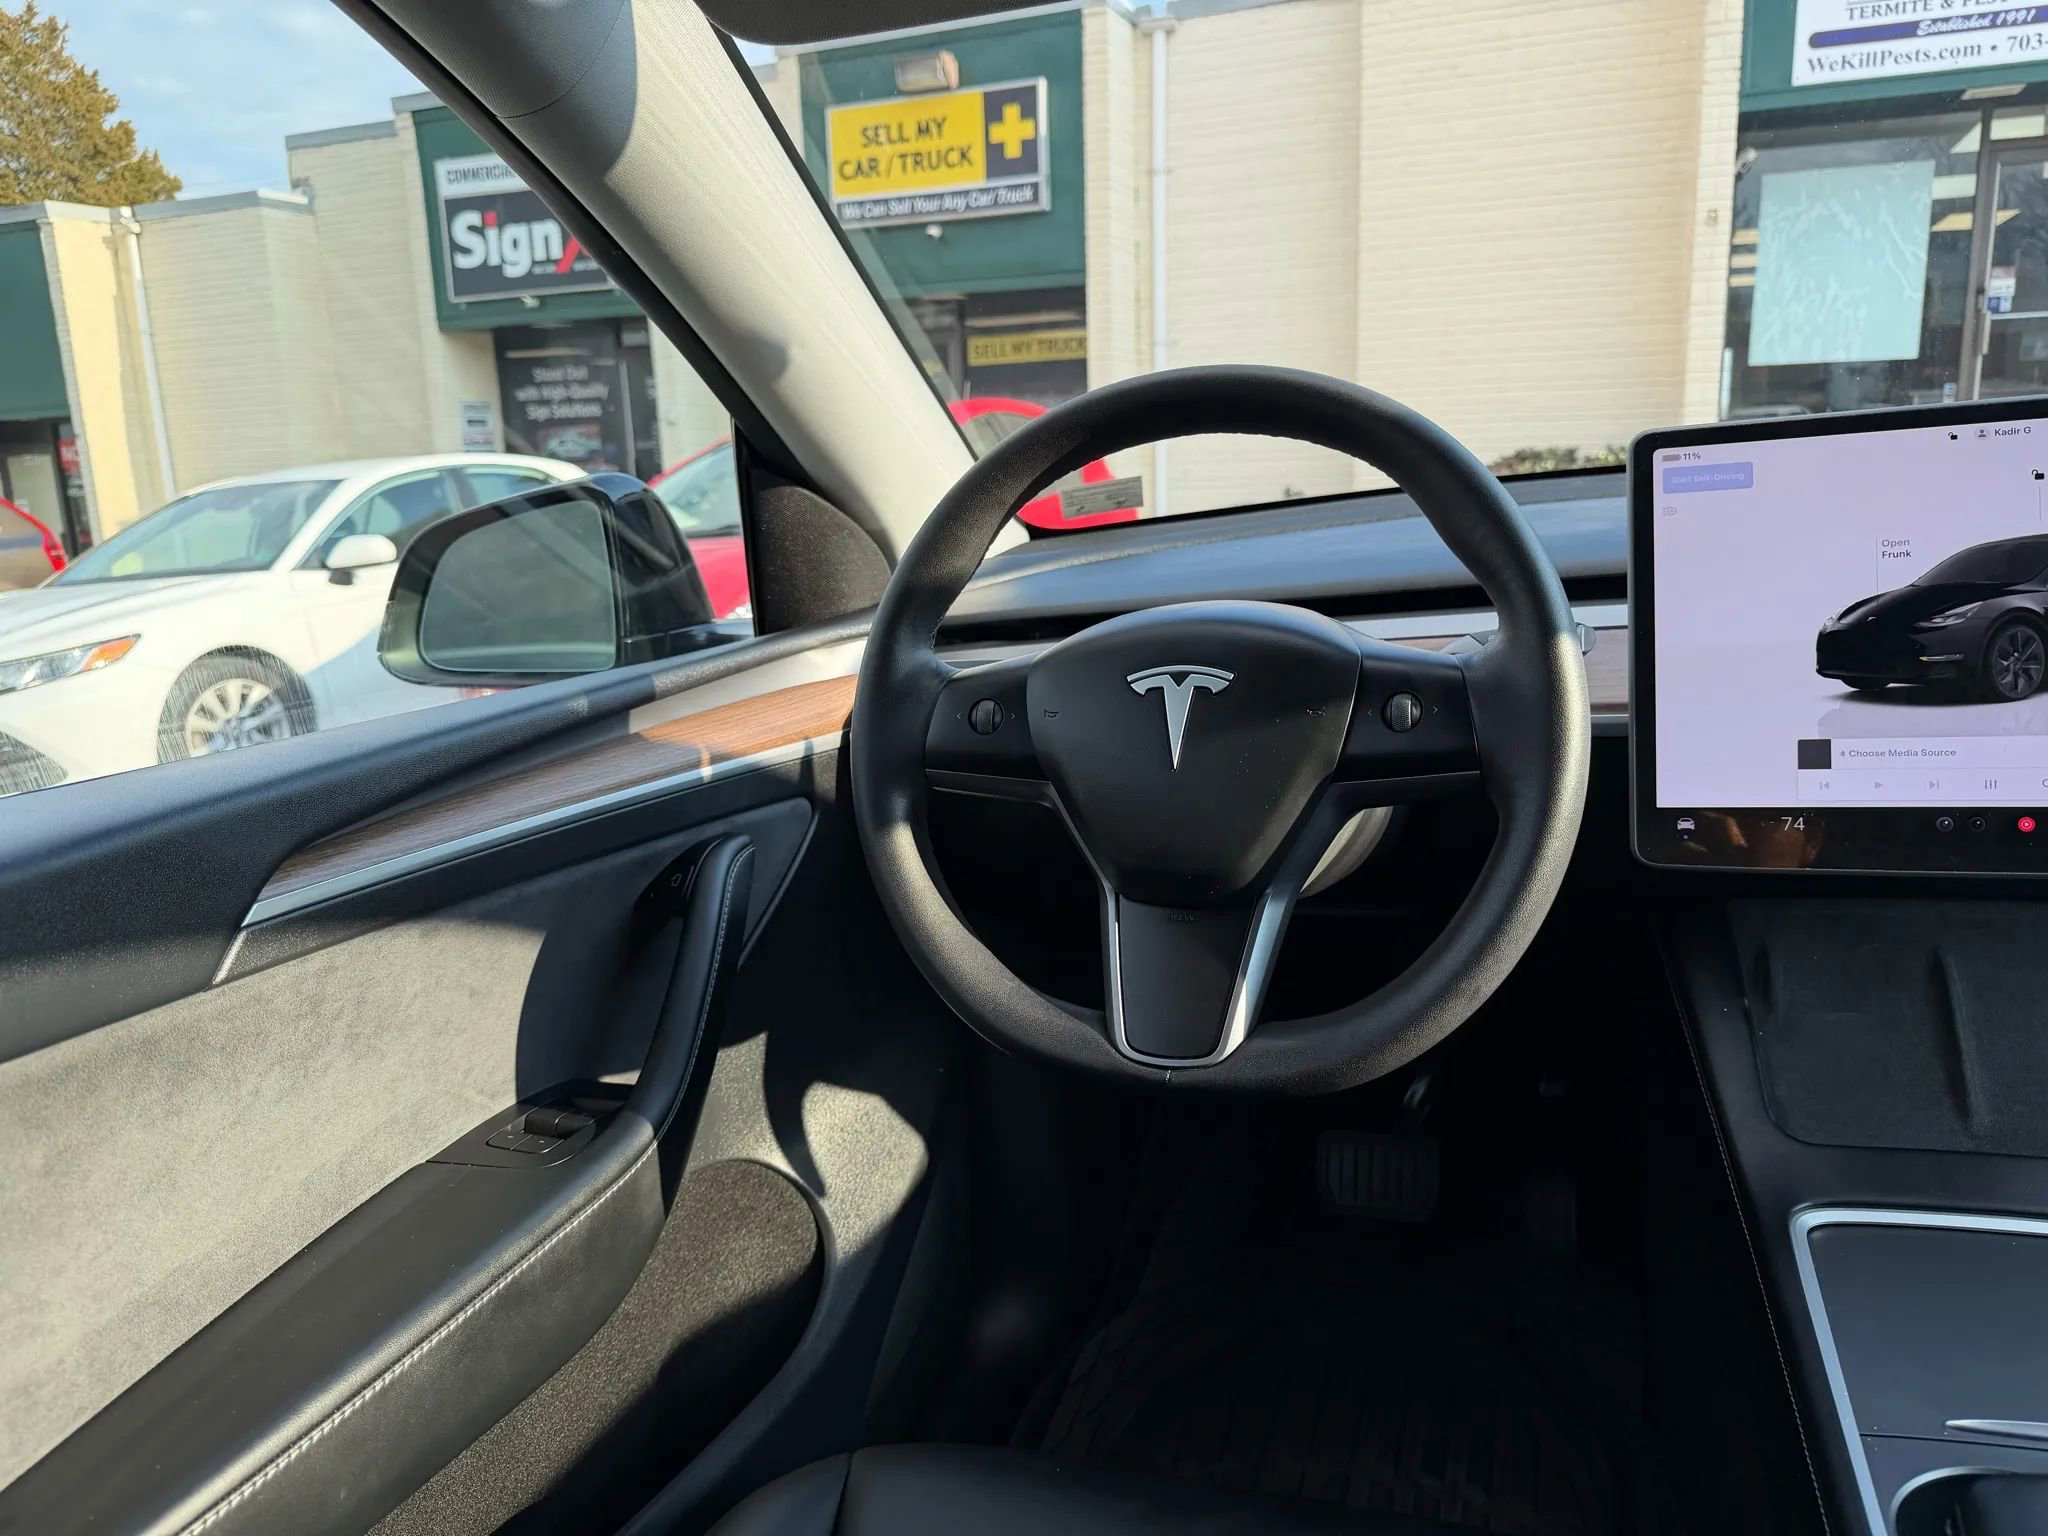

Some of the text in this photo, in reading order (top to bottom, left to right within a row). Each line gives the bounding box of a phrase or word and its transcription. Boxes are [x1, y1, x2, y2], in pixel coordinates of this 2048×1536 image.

[1846, 0, 1933, 20] TERMITE
[1916, 8, 2036, 36] Established 1991
[1807, 44, 1982, 73] WeKillPests.com
[861, 116, 947, 148] SELL MY
[1994, 426, 2032, 437] Kadir G
[1683, 452, 1701, 461] 11%
[1881, 539, 1910, 549] Open
[1882, 549, 1912, 559] Frunk
[1848, 748, 1957, 758] Choose Media Source
[1780, 816, 1805, 831] 74
